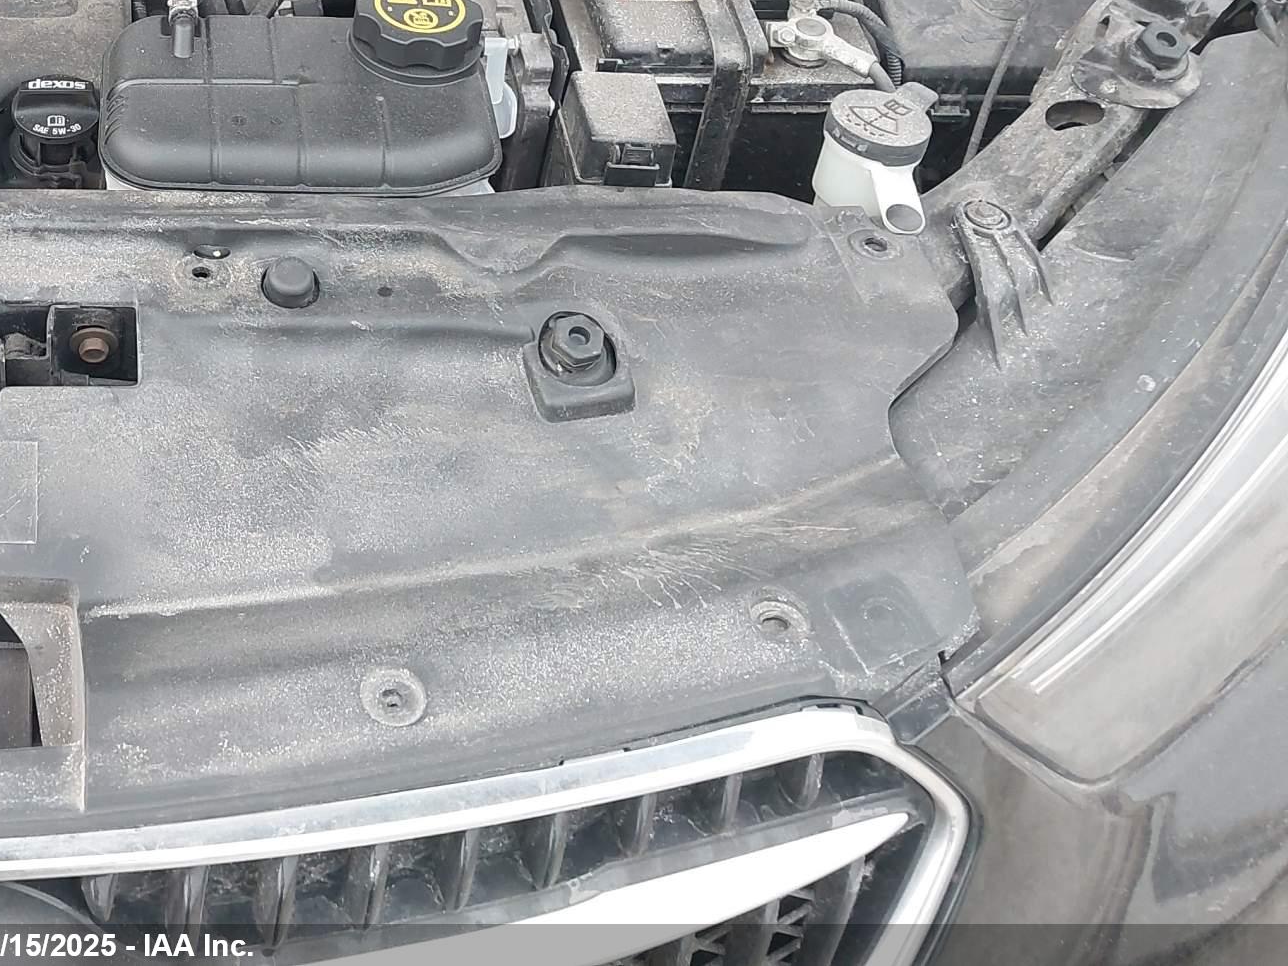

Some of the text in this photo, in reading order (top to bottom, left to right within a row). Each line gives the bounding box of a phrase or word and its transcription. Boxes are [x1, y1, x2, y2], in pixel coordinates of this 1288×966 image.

[28, 78, 86, 90] dexos
[32, 123, 82, 135] SAE 5W-30
